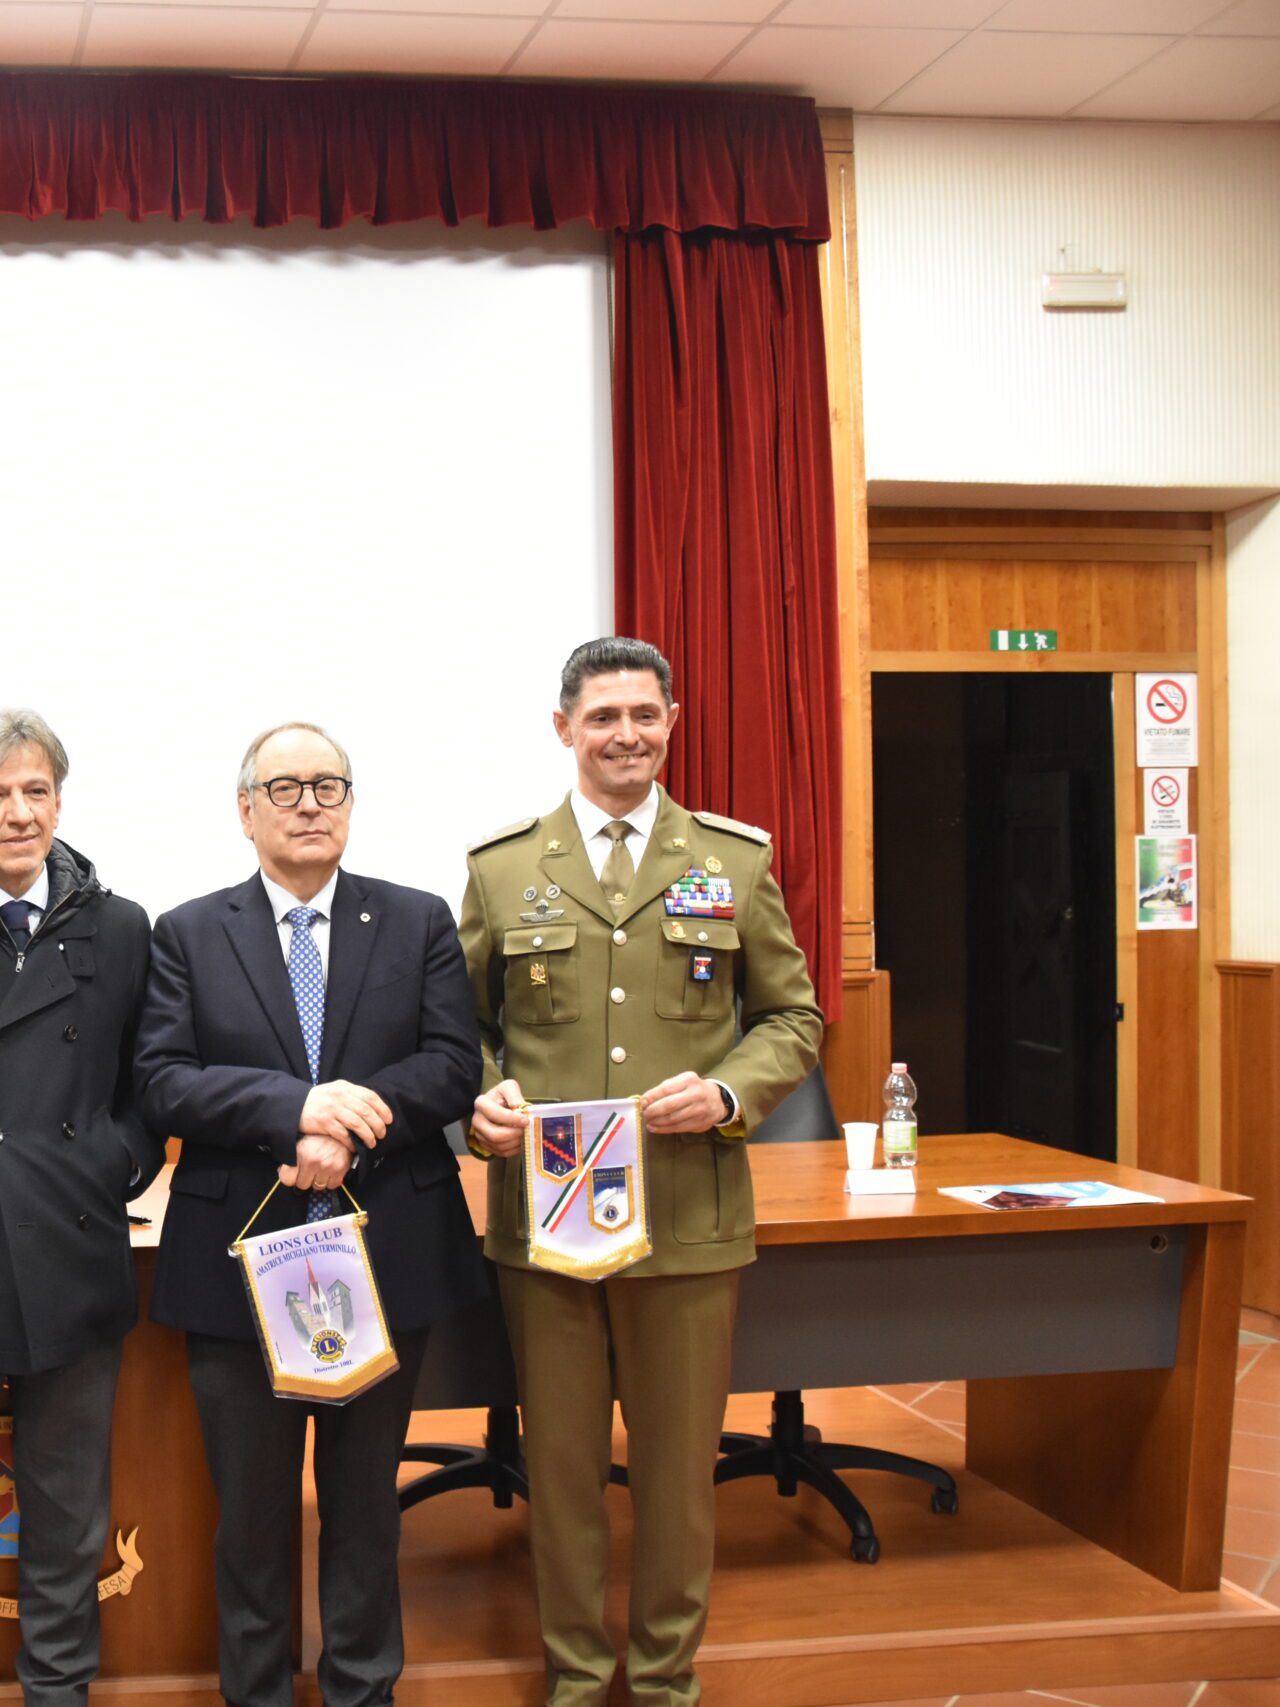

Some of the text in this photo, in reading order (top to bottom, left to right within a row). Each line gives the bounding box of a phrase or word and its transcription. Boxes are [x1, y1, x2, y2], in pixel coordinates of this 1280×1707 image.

[258, 1227, 343, 1257] LIONS CLUB
[255, 1244, 357, 1278] AMATRICE MICIGLIANO TERMINILLO
[323, 1340, 335, 1353] L
